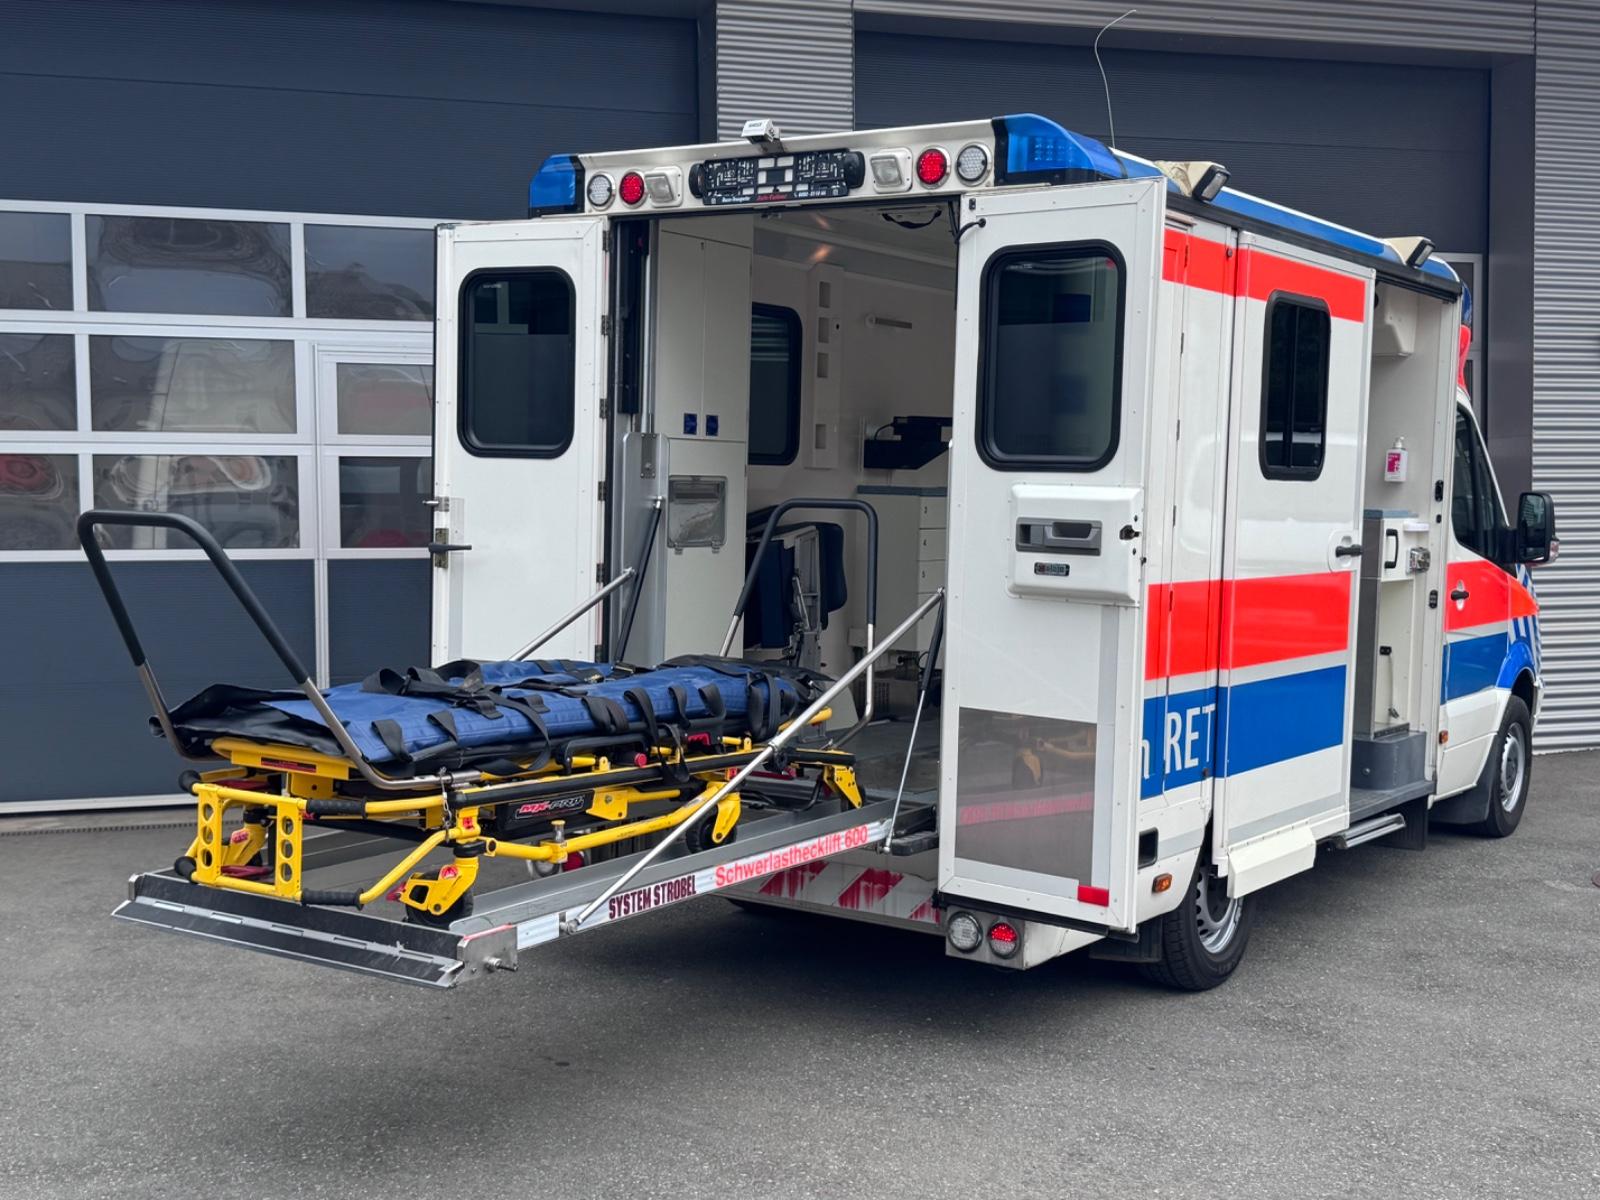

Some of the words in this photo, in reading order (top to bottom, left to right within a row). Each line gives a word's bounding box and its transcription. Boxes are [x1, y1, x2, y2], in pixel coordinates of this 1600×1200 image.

[1165, 703, 1216, 774] RET
[608, 885, 651, 919] SYSTEM
[653, 875, 697, 907] STROBEL
[715, 833, 842, 887] Schwerlasthecklift
[844, 825, 868, 850] 600
